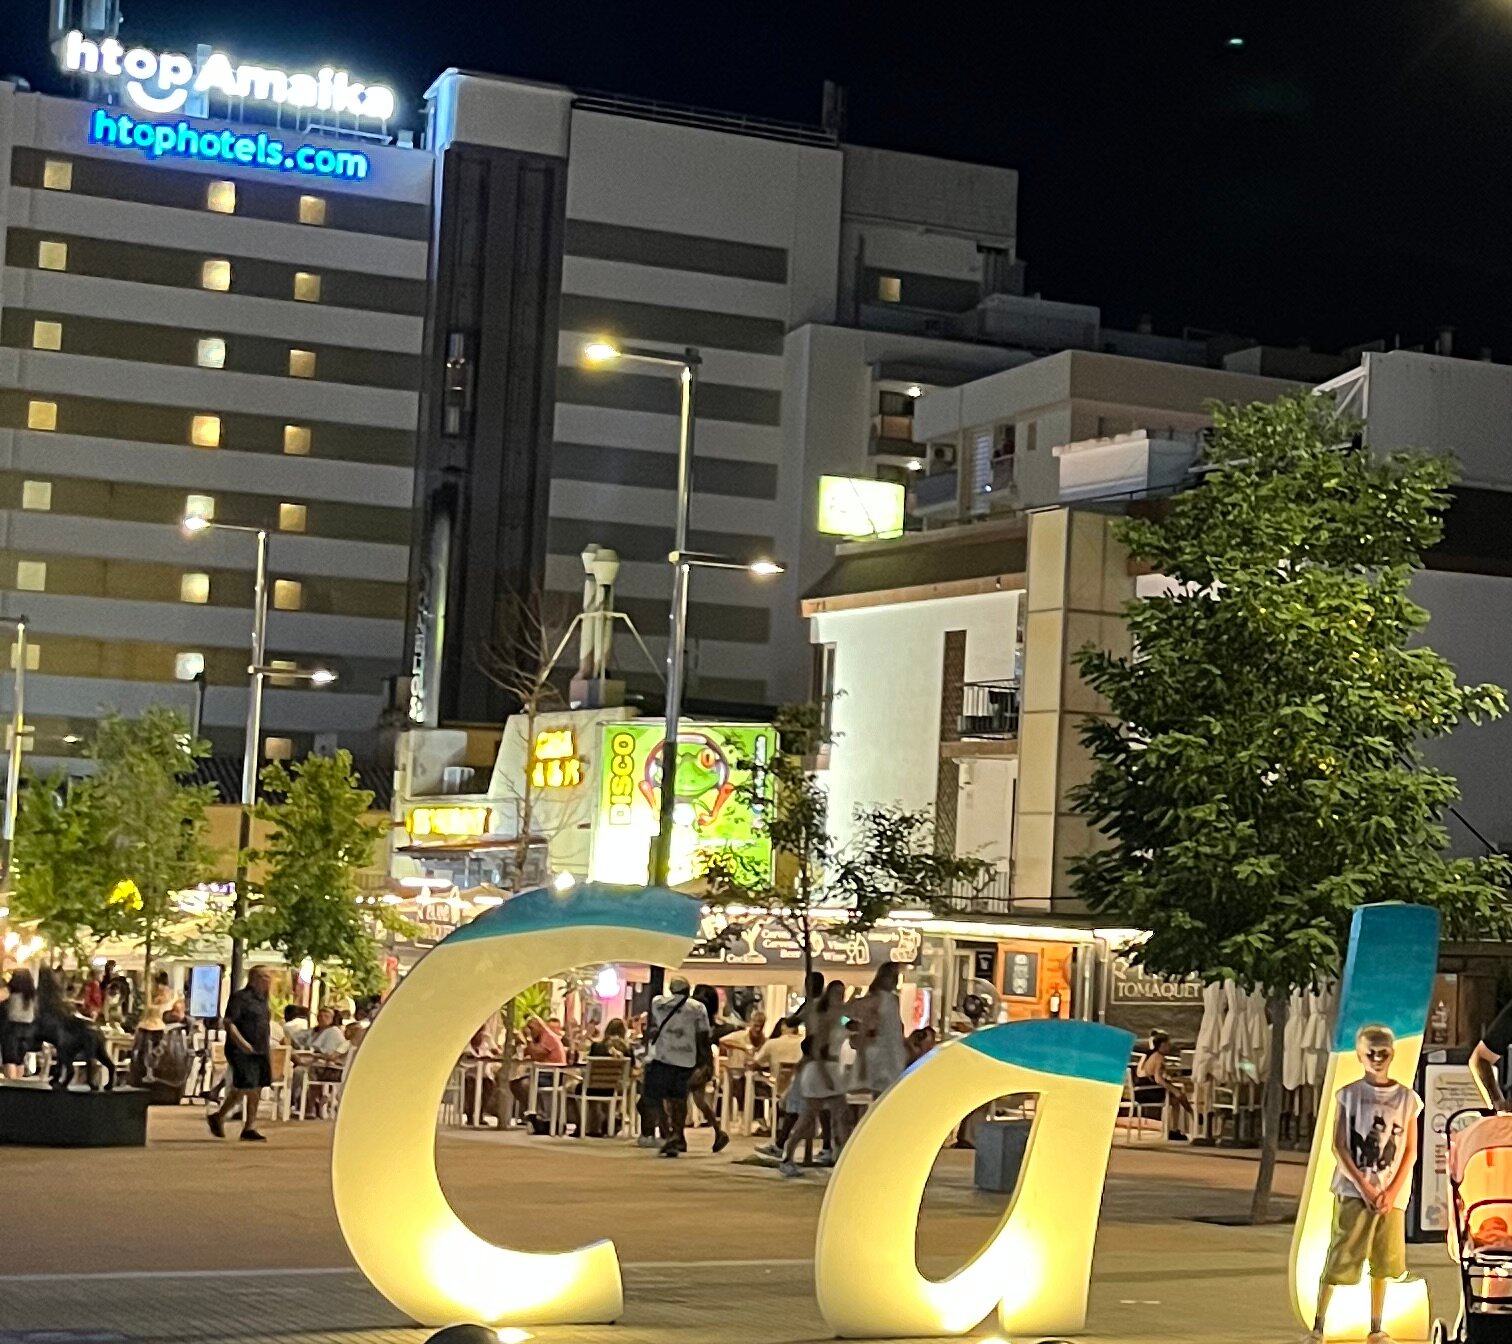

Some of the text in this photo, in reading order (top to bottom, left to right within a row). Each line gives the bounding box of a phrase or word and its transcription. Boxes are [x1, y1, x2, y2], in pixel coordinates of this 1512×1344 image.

[65, 29, 396, 120] htop Amaika
[93, 108, 369, 179] htophotels.com
[608, 732, 636, 826] DISCO
[1117, 982, 1201, 999] TOMAQUET
